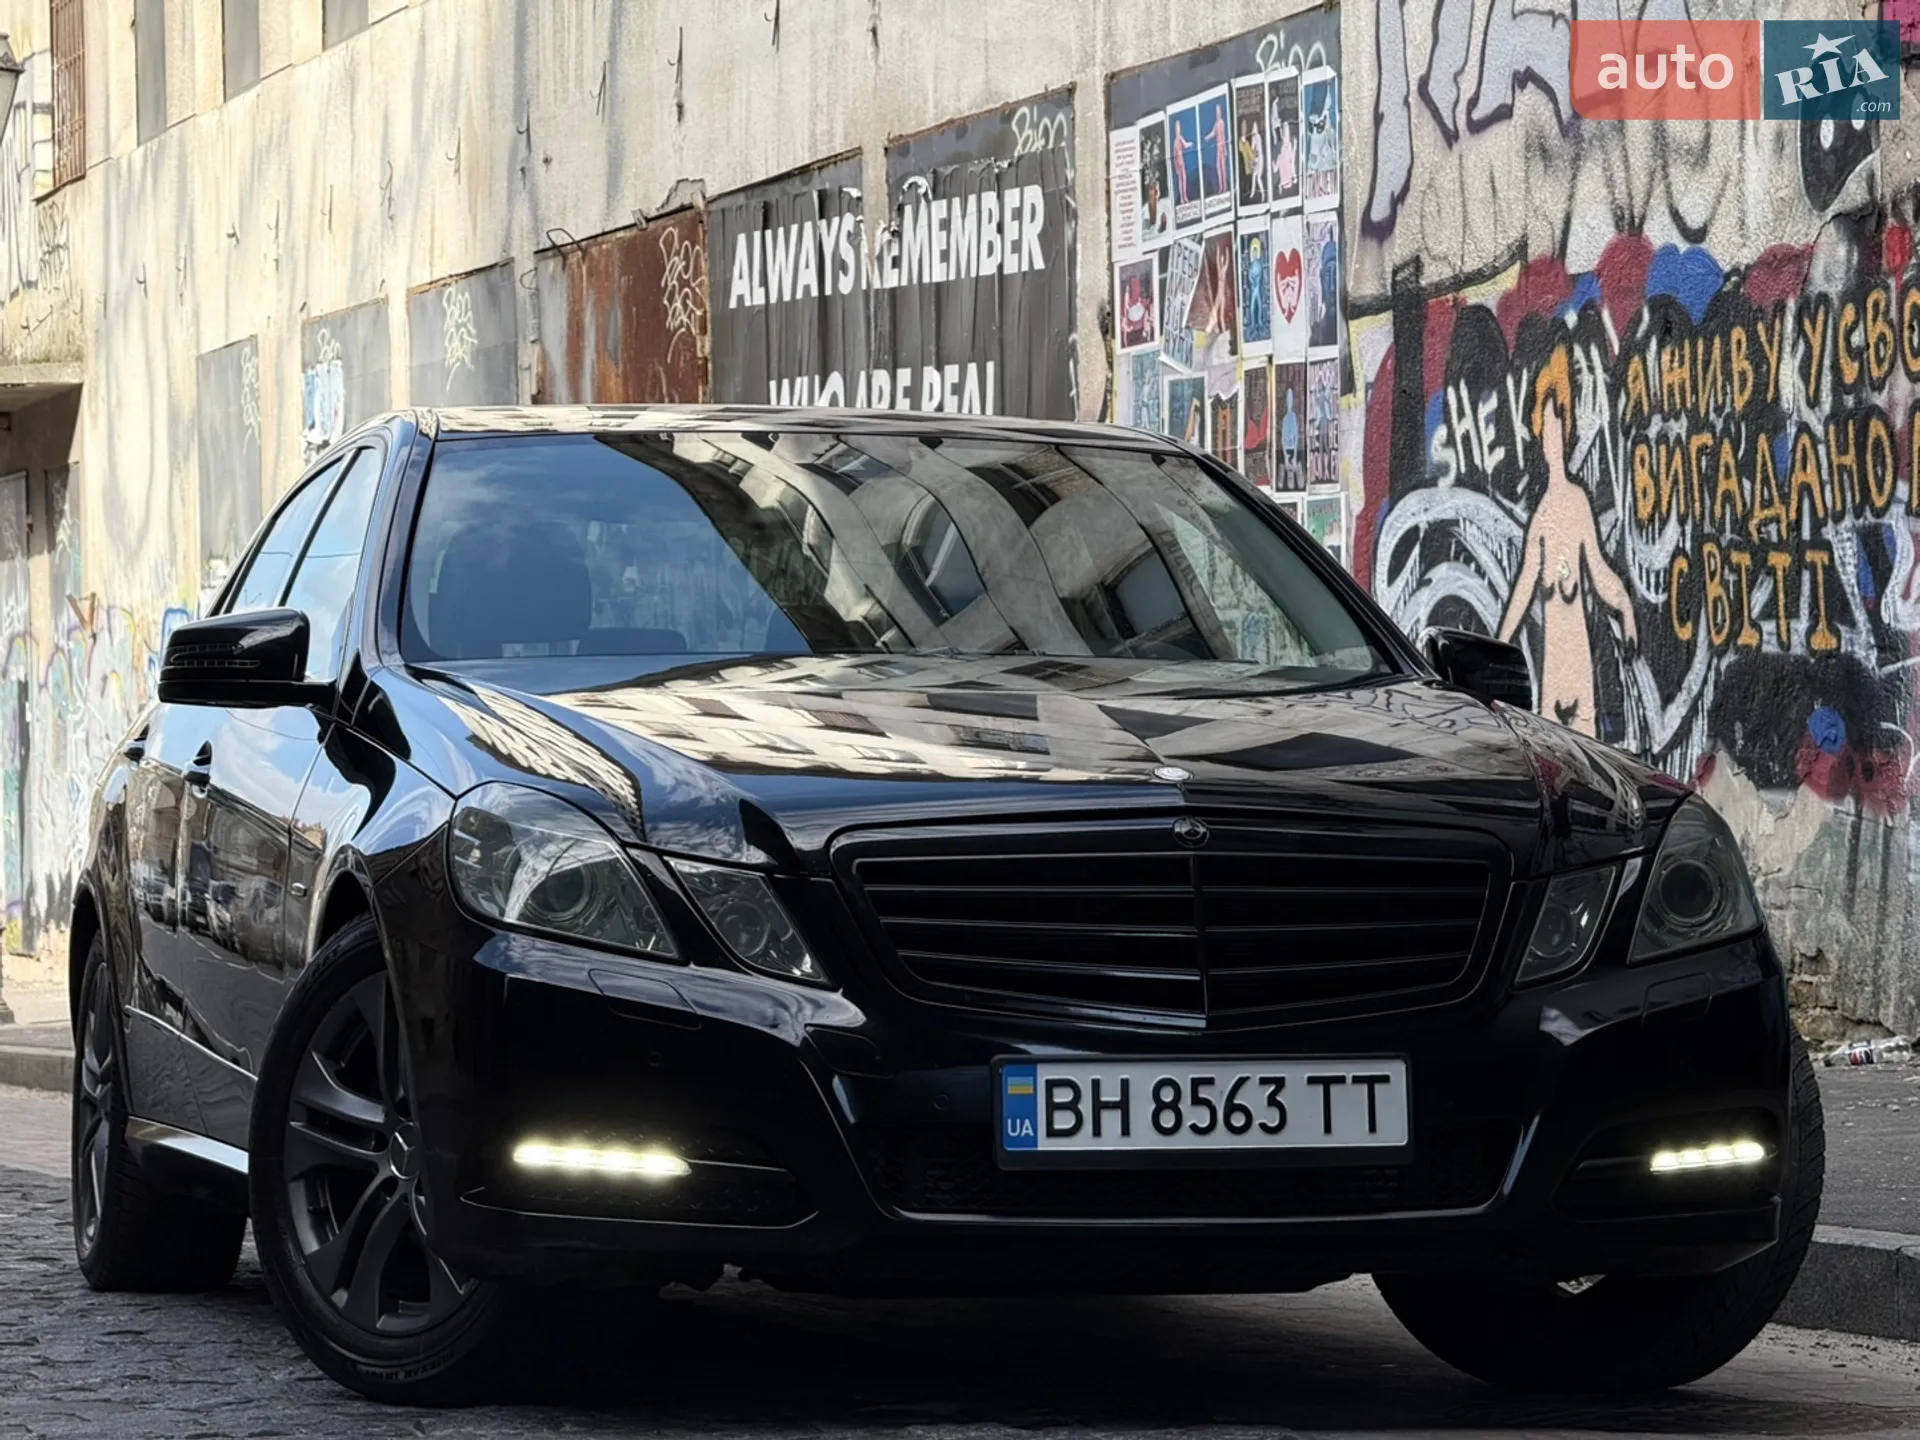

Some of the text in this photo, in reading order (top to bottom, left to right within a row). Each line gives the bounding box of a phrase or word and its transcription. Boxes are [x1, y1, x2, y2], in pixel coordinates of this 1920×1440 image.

[729, 211, 856, 309] ALWAYS
[1625, 353, 1649, 424] Я
[1660, 317, 1783, 419] ЖИВУ
[1802, 304, 1825, 403] У
[1670, 541, 1839, 651] СВІТІ
[1007, 1118, 1034, 1137] UA
[1044, 1074, 1391, 1139] BH 8563 TT
